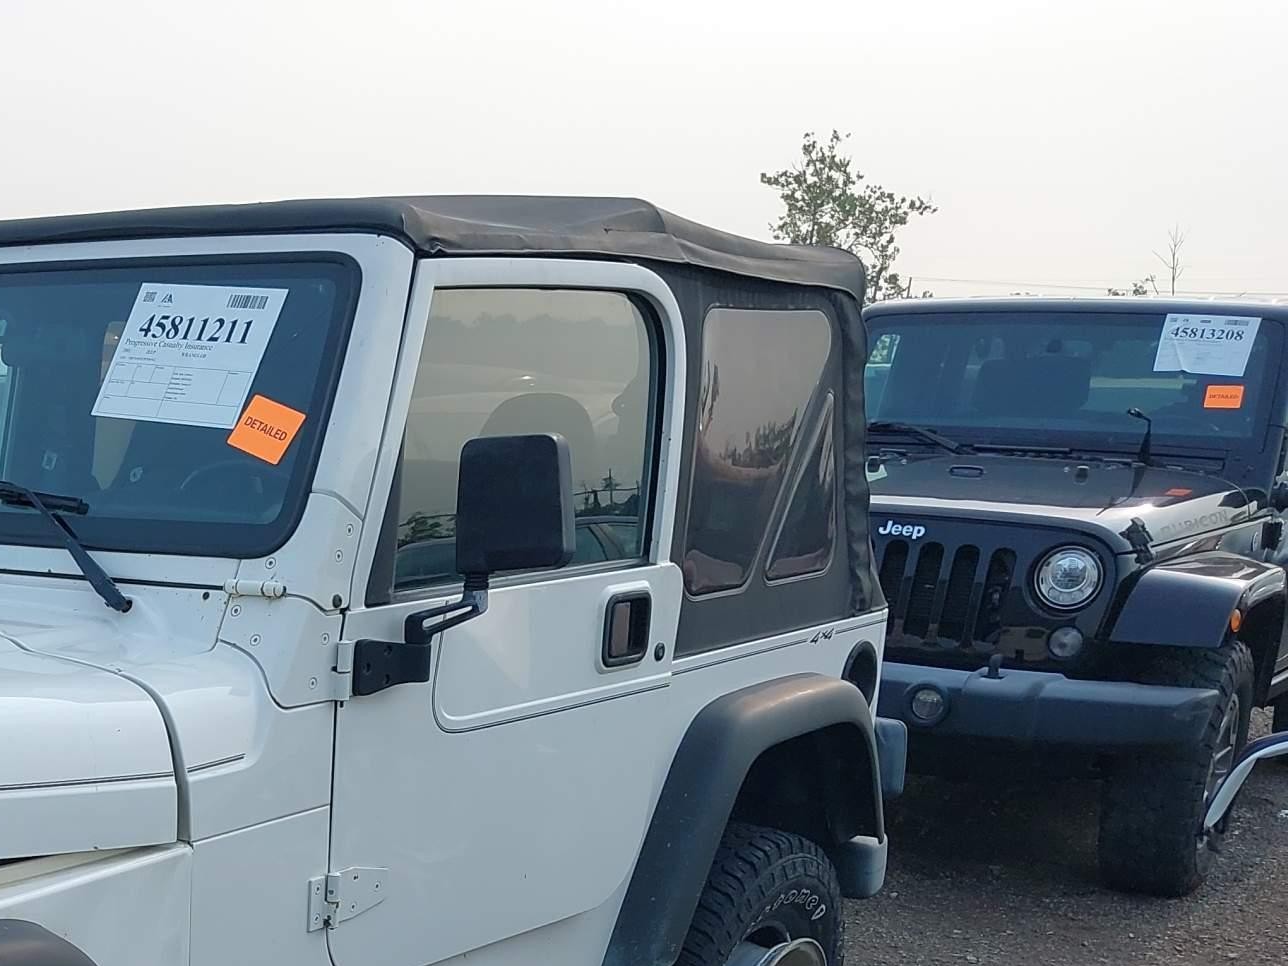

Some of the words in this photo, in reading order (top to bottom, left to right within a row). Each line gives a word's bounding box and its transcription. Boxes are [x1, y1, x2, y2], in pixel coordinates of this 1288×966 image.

[139, 313, 254, 345] 45811211
[1171, 327, 1245, 341] 45813208
[125, 337, 158, 349] Progressive
[158, 340, 183, 351] Casualty
[184, 342, 214, 352] Insurance
[244, 416, 288, 441] DETAILED
[878, 520, 926, 540] Jeep
